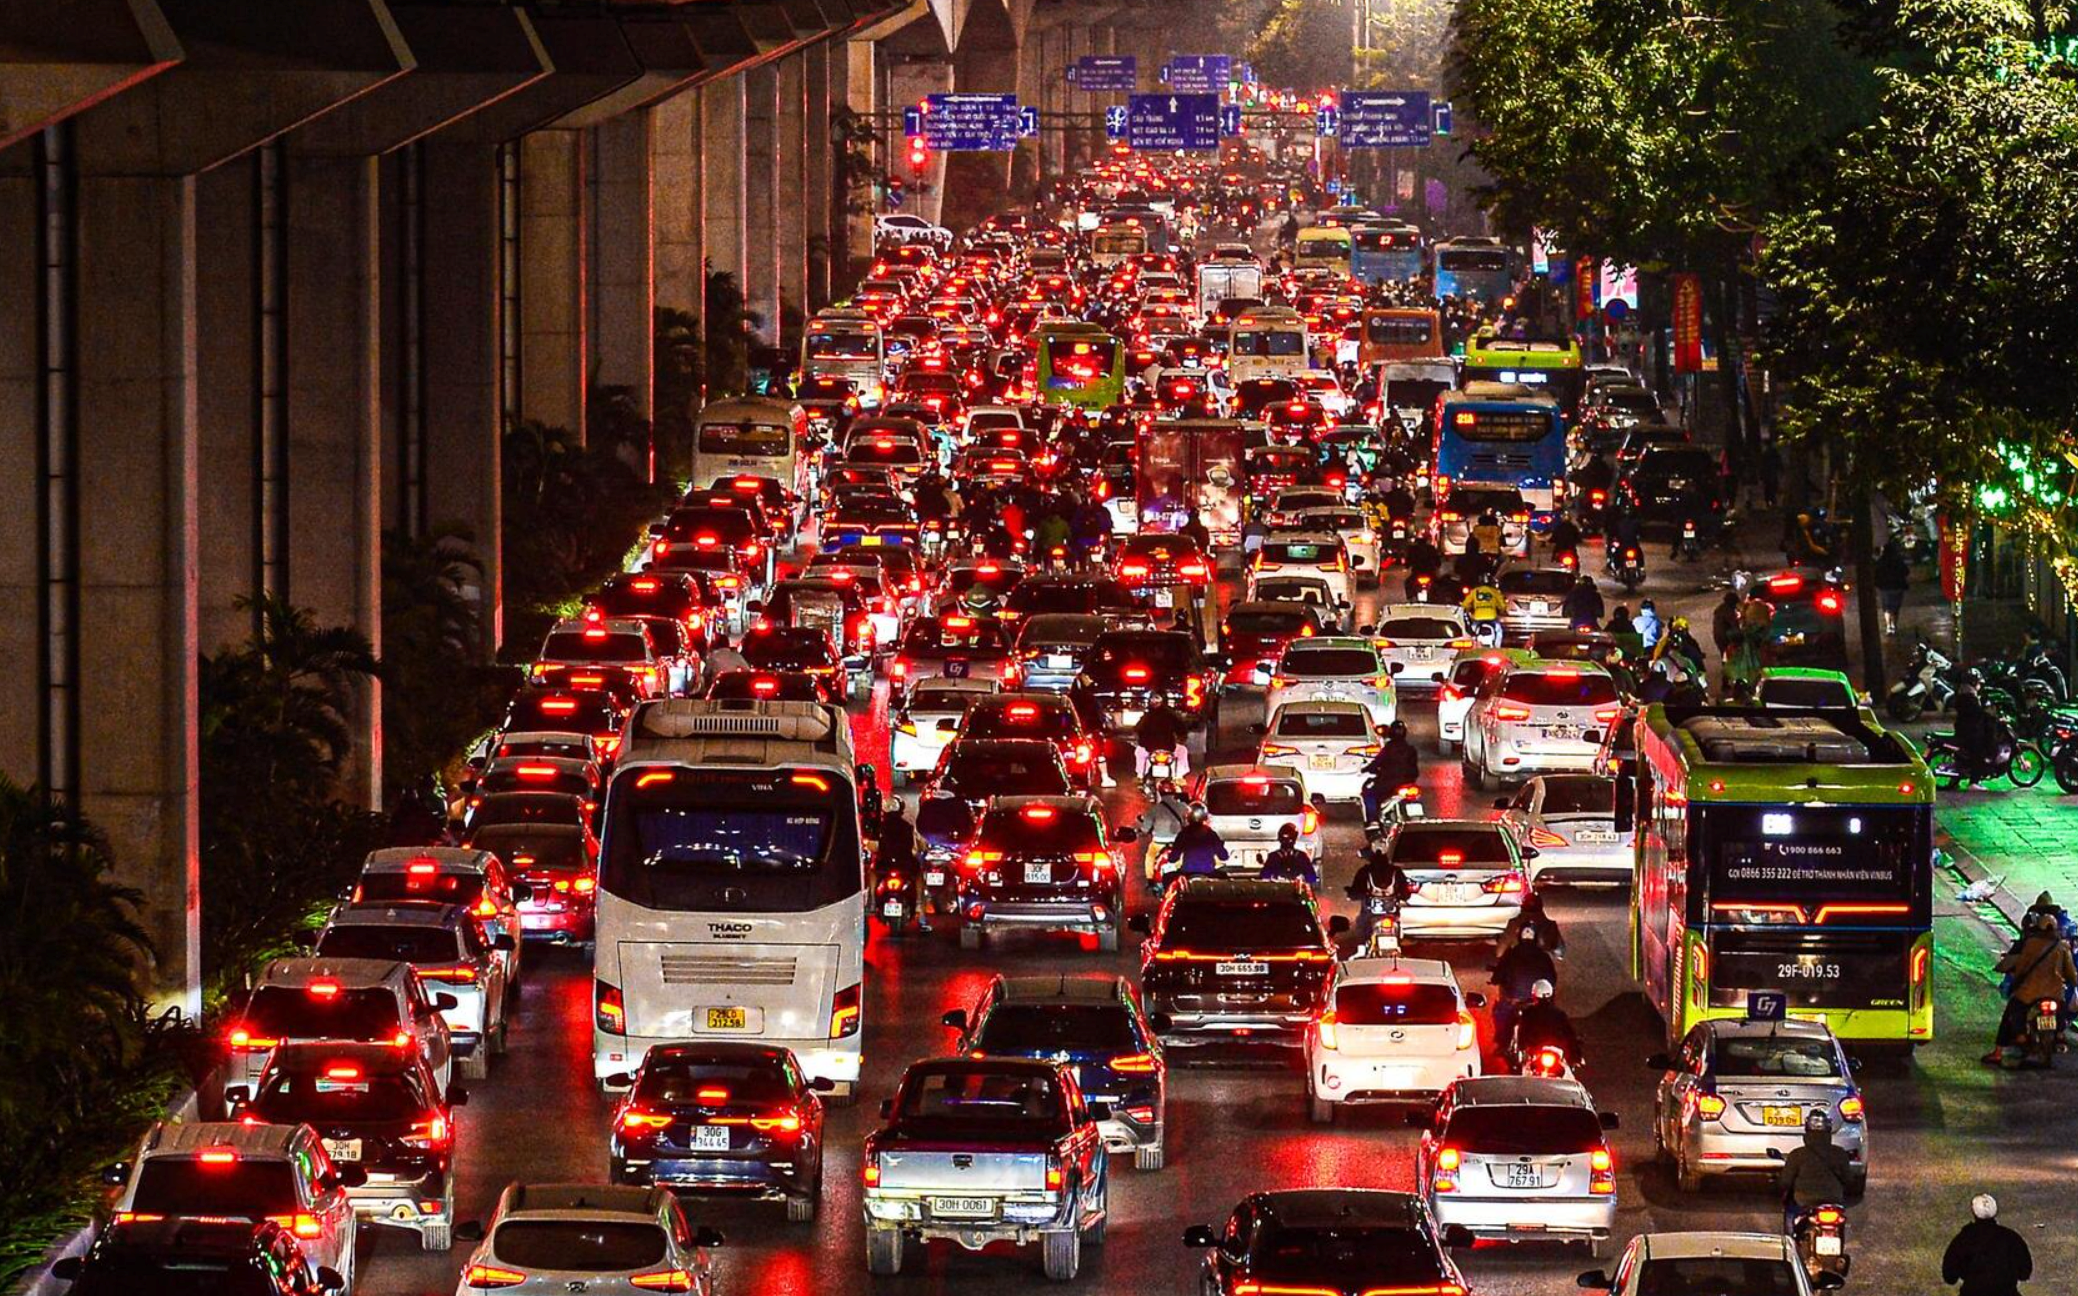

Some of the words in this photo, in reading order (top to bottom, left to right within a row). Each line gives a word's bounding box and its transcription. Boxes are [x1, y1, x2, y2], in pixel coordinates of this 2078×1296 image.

[1741, 867, 1760, 879] 0866
[1761, 867, 1776, 879] 355
[1777, 867, 1791, 879] 222
[708, 923, 752, 932] THACO
[1777, 963, 1840, 978] 29F-019.53
[1757, 996, 1777, 1015] G7
[704, 1126, 722, 1137] 30G
[1516, 1164, 1534, 1175] 29A
